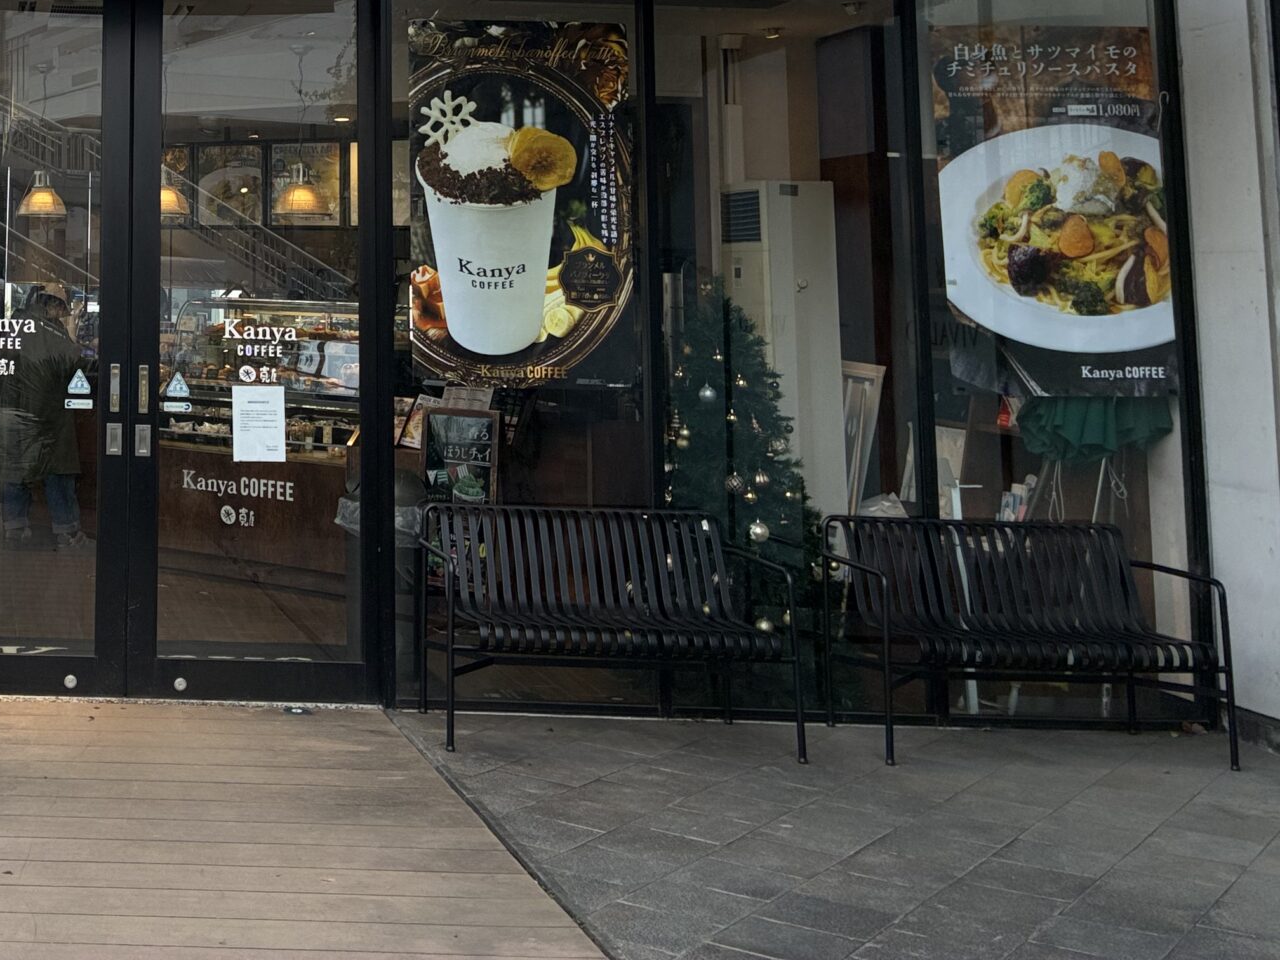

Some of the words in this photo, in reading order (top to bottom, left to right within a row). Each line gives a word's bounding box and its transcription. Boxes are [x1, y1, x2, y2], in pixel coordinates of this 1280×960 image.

[953, 43, 1138, 61] 白身魚とサツマイモの
[946, 61, 1139, 79] チミチュリソースパスタ
[1098, 104, 1140, 117] 1,080円
[458, 258, 527, 278] Kanya
[471, 279, 515, 290] COFFEE
[223, 318, 297, 343] Kanya
[237, 344, 283, 358] COFFEE
[481, 365, 525, 379] Kanya
[527, 367, 568, 379] COFFEE
[1081, 365, 1124, 381] Kanya
[1125, 366, 1166, 379] COFFEE
[444, 445, 491, 461] ほうじチャイ
[182, 470, 237, 496] Kanya
[240, 477, 294, 501] COFFEE
